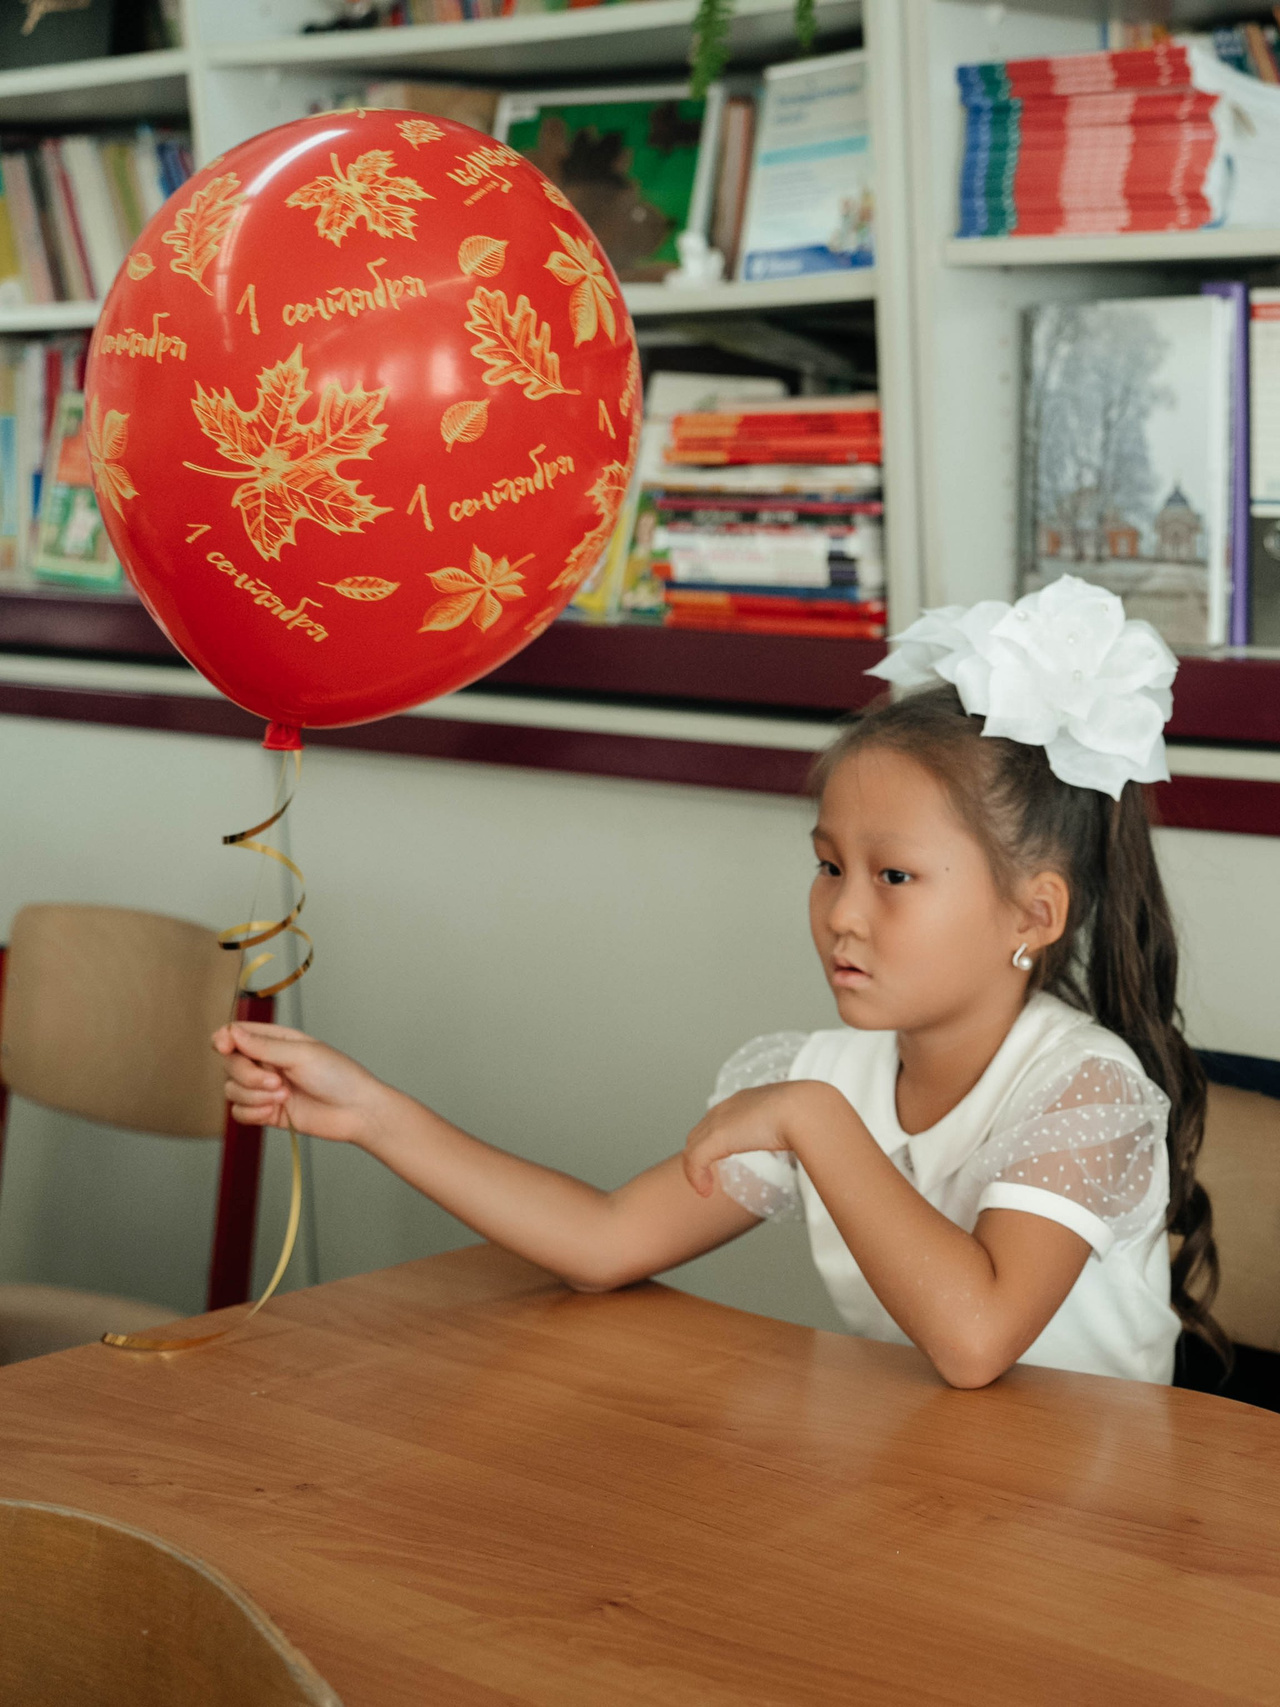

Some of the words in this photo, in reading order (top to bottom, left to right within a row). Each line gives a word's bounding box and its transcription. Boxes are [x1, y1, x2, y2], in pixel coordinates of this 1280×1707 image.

[236, 283, 261, 335] 1
[282, 257, 428, 326] сентября
[406, 484, 434, 532] 1
[449, 443, 575, 522] сентября
[206, 551, 329, 643] сентября
